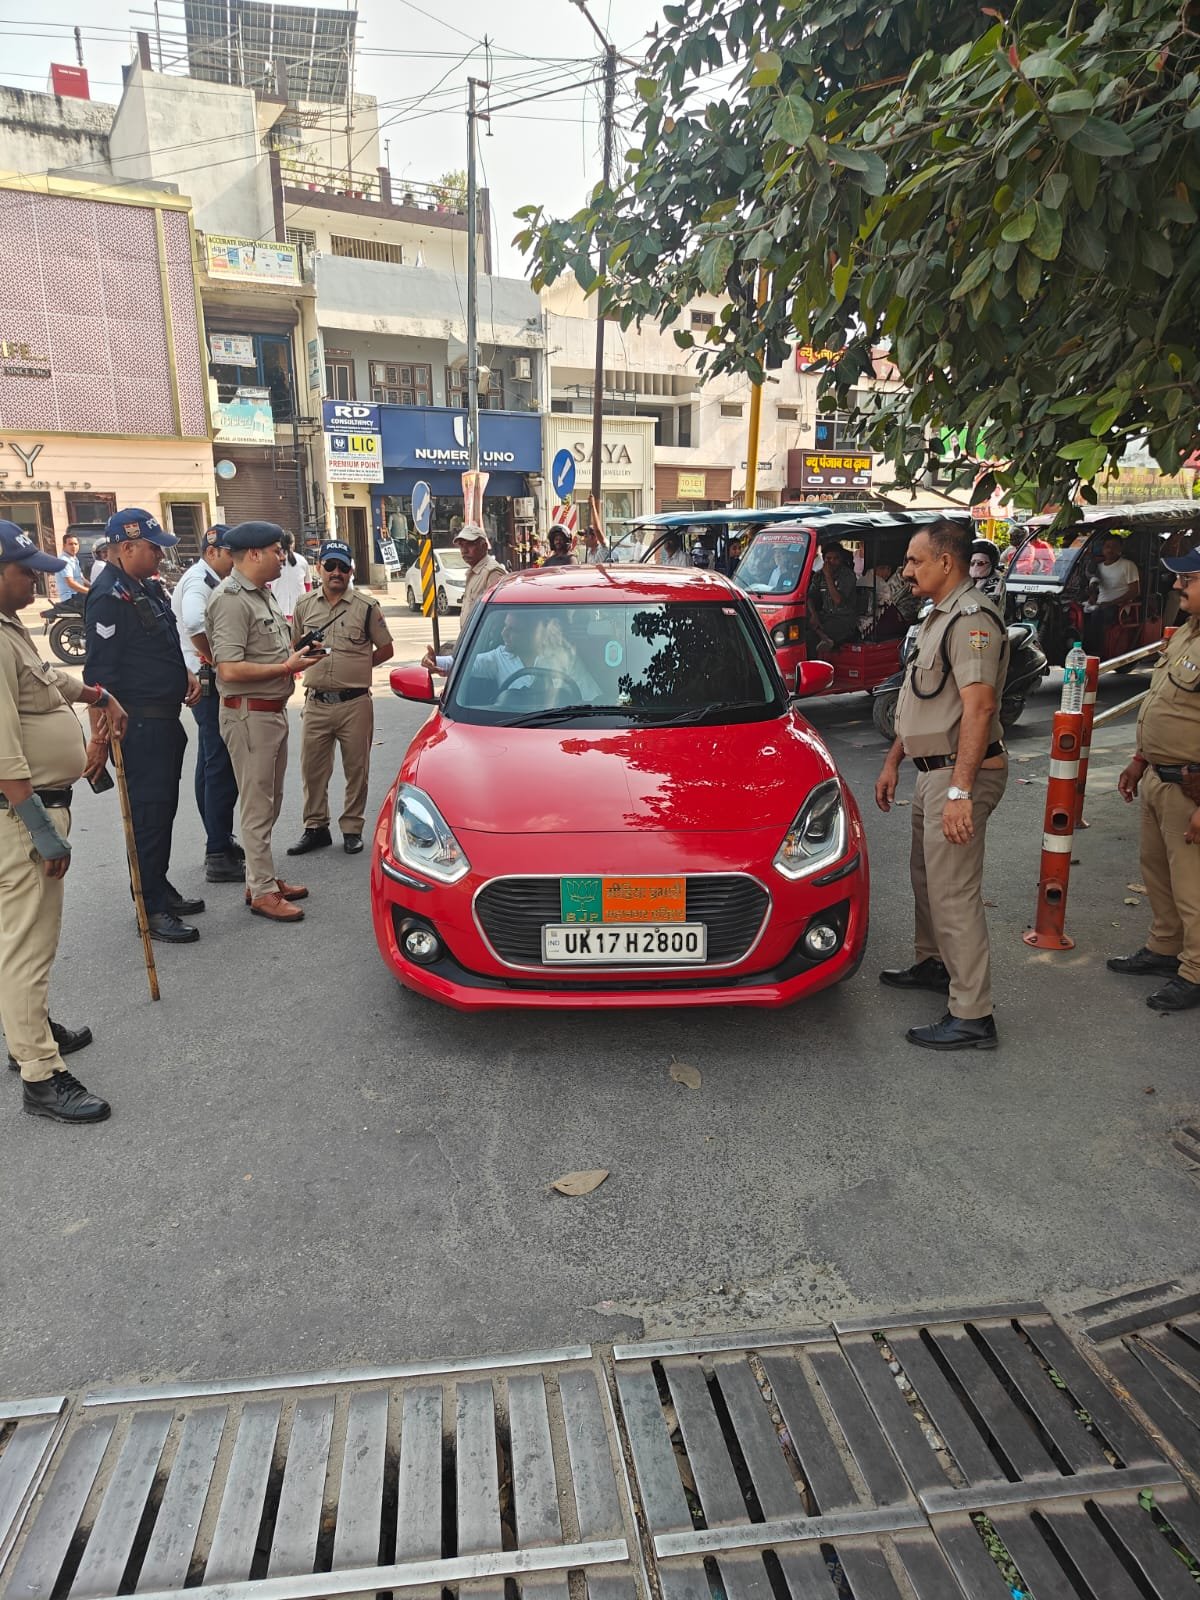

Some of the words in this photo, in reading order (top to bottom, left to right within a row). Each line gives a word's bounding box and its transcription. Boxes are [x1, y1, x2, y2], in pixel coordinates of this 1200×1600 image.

[209, 237, 236, 245] ACCURATE
[238, 240, 269, 250] INSURANCE
[269, 245, 296, 253] SOLUTION
[6, 367, 29, 375] SINCE
[335, 405, 370, 418] RD
[331, 418, 374, 427] CONSULTANCY
[351, 437, 374, 452] LIC
[415, 448, 470, 460] NUMER
[483, 451, 515, 462] UNO
[329, 460, 360, 469] PREMIUM
[360, 461, 380, 470] POINT
[805, 456, 820, 473] न्यू
[820, 454, 843, 469] पंजाब
[843, 456, 852, 469] दा
[56, 481, 92, 490] LTD
[681, 479, 690, 487] TO
[691, 479, 702, 487] LET
[326, 543, 349, 552] POLICE
[566, 912, 599, 923] BJP
[548, 938, 560, 947] IND
